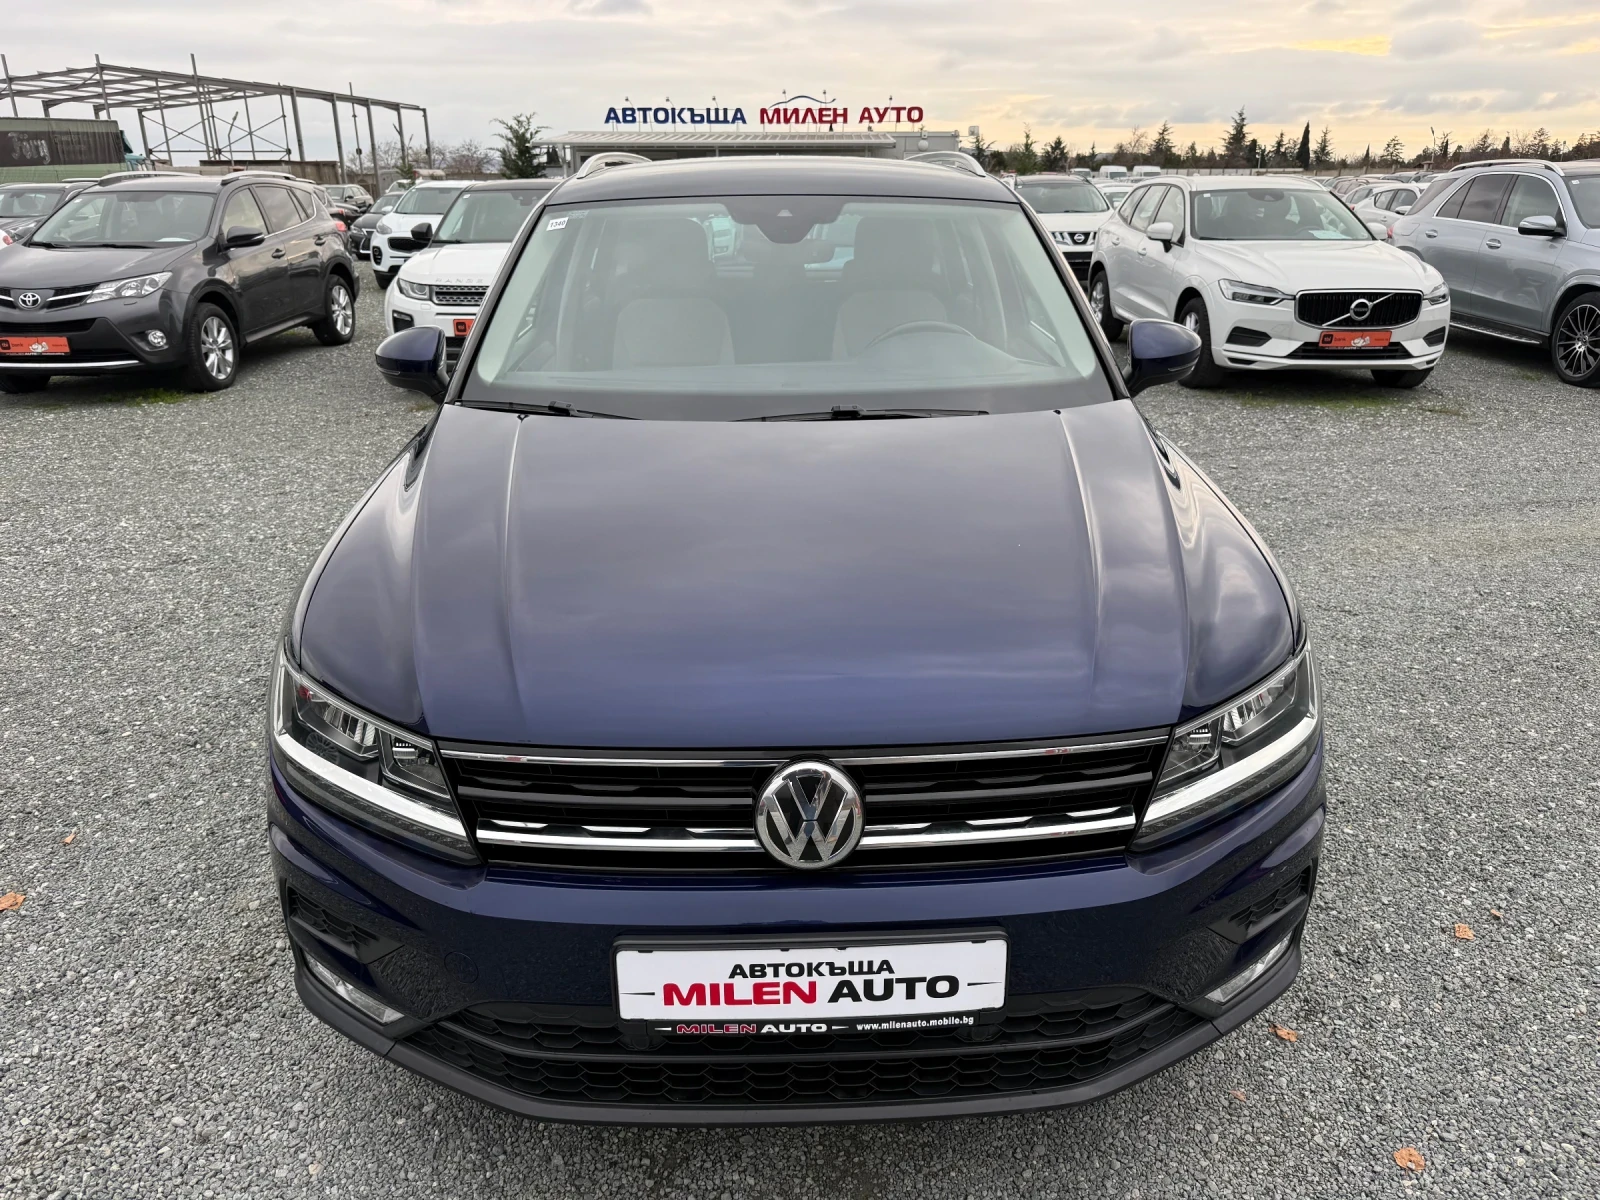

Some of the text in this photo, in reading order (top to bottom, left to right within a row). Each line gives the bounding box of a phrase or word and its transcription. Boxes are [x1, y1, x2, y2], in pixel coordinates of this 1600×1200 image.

[604, 106, 924, 125] АВТОКЪЩА МИЛЕН АУТО
[728, 959, 895, 979] АВТОКЪЩА
[663, 974, 960, 1006] MILEN AUTO
[676, 1015, 974, 1034] MILEN AUTO www.milenauto.mobile.bg
